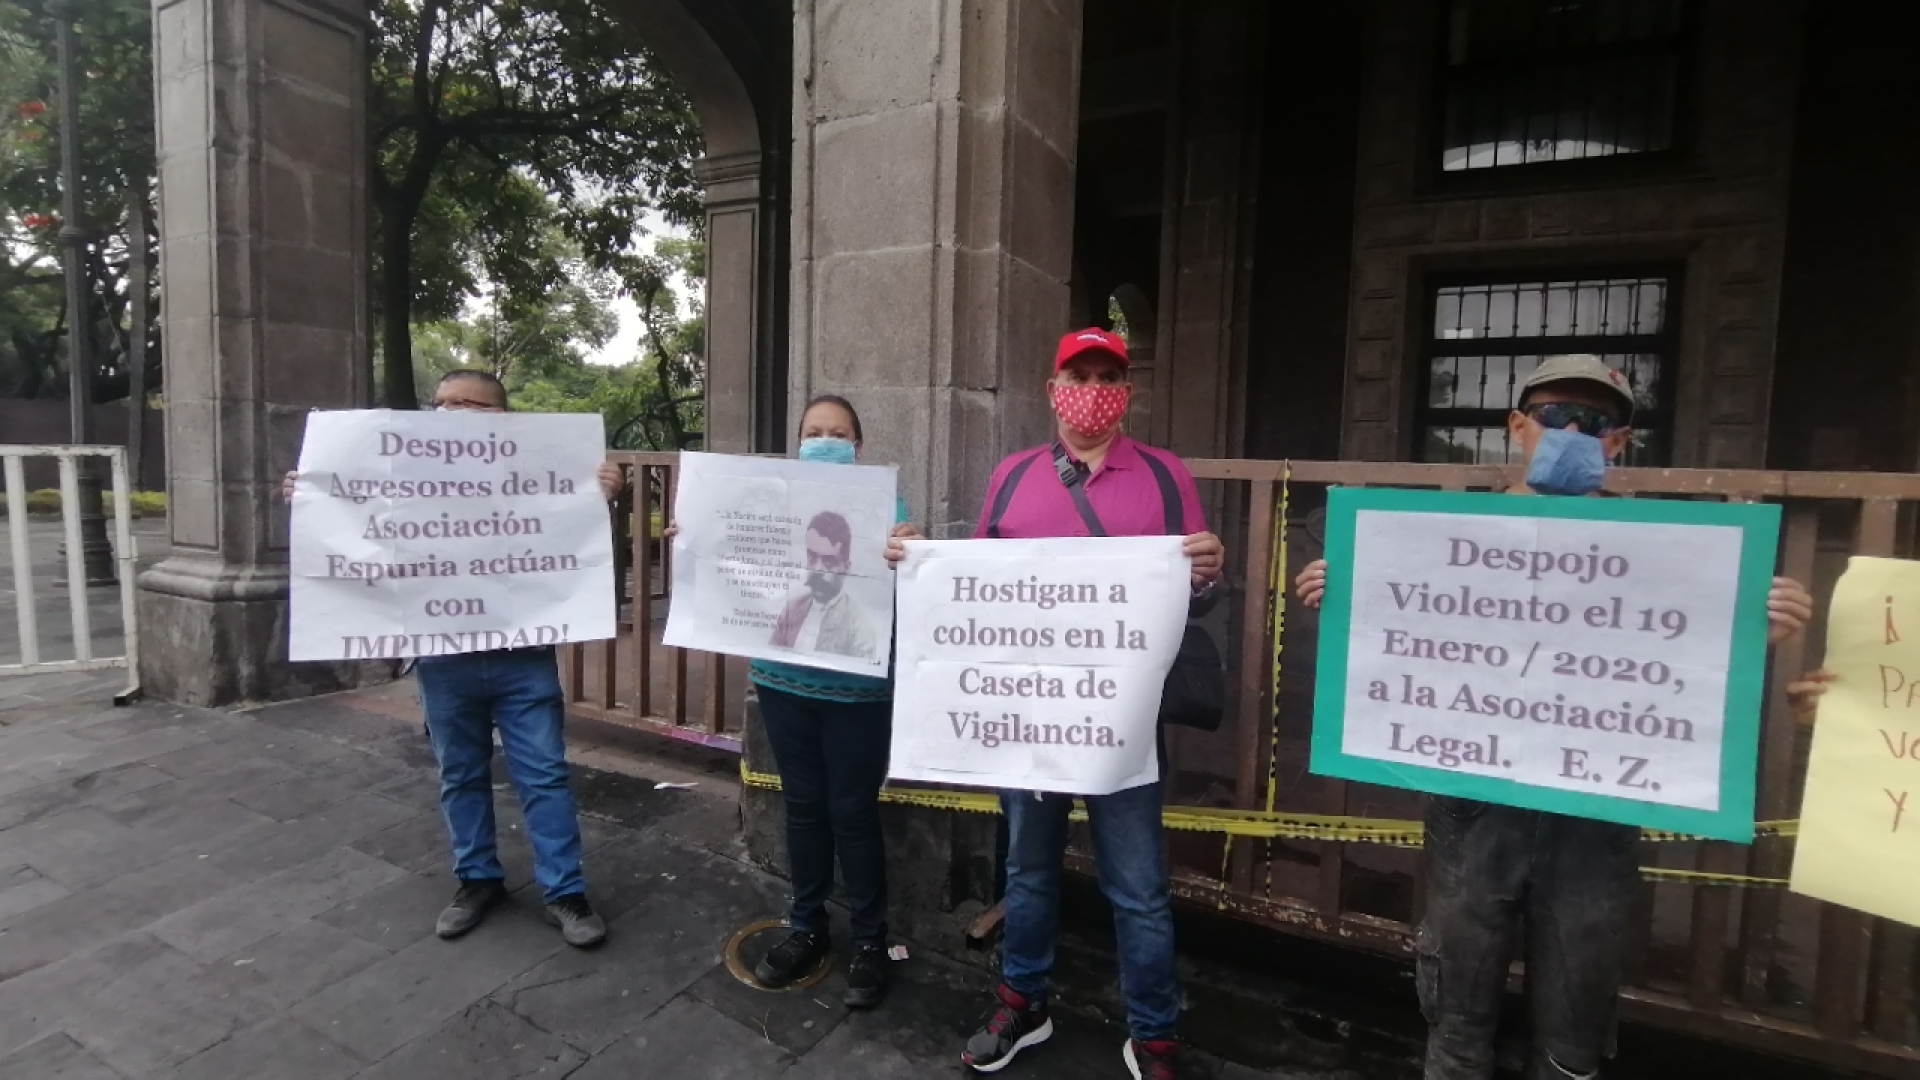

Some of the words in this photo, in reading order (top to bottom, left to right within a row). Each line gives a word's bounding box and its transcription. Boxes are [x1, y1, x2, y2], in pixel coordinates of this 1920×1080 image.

[378, 431, 518, 464] Despojo
[328, 472, 493, 504] Agresores
[501, 471, 540, 496] de
[547, 471, 576, 495] la
[361, 511, 544, 540] Asociación
[325, 554, 460, 587] Espuria
[468, 549, 579, 576] actúan
[1446, 537, 1630, 584] Despojo
[424, 597, 487, 617] con
[951, 575, 1099, 609] Hostigan
[1108, 583, 1129, 604] a
[1387, 581, 1570, 625] Violento
[1583, 598, 1622, 630] el
[1636, 608, 1687, 640] 19
[341, 623, 570, 660] IMPUNIDAD!
[933, 617, 1055, 648] colonos
[1064, 627, 1106, 649] en
[1115, 620, 1148, 651] la
[1382, 628, 1508, 668] Enero
[1520, 641, 1540, 677] /
[1552, 651, 1687, 695] 2020,
[959, 667, 1065, 698] Caseta
[1076, 669, 1118, 699] de
[1368, 679, 1390, 702] a
[1400, 674, 1437, 708] la
[1447, 683, 1696, 742] Asociación
[947, 711, 1126, 748] Vigilancia.
[1388, 722, 1513, 768] Legal.
[1560, 747, 1603, 783] E.
[1615, 754, 1662, 792] Z.
